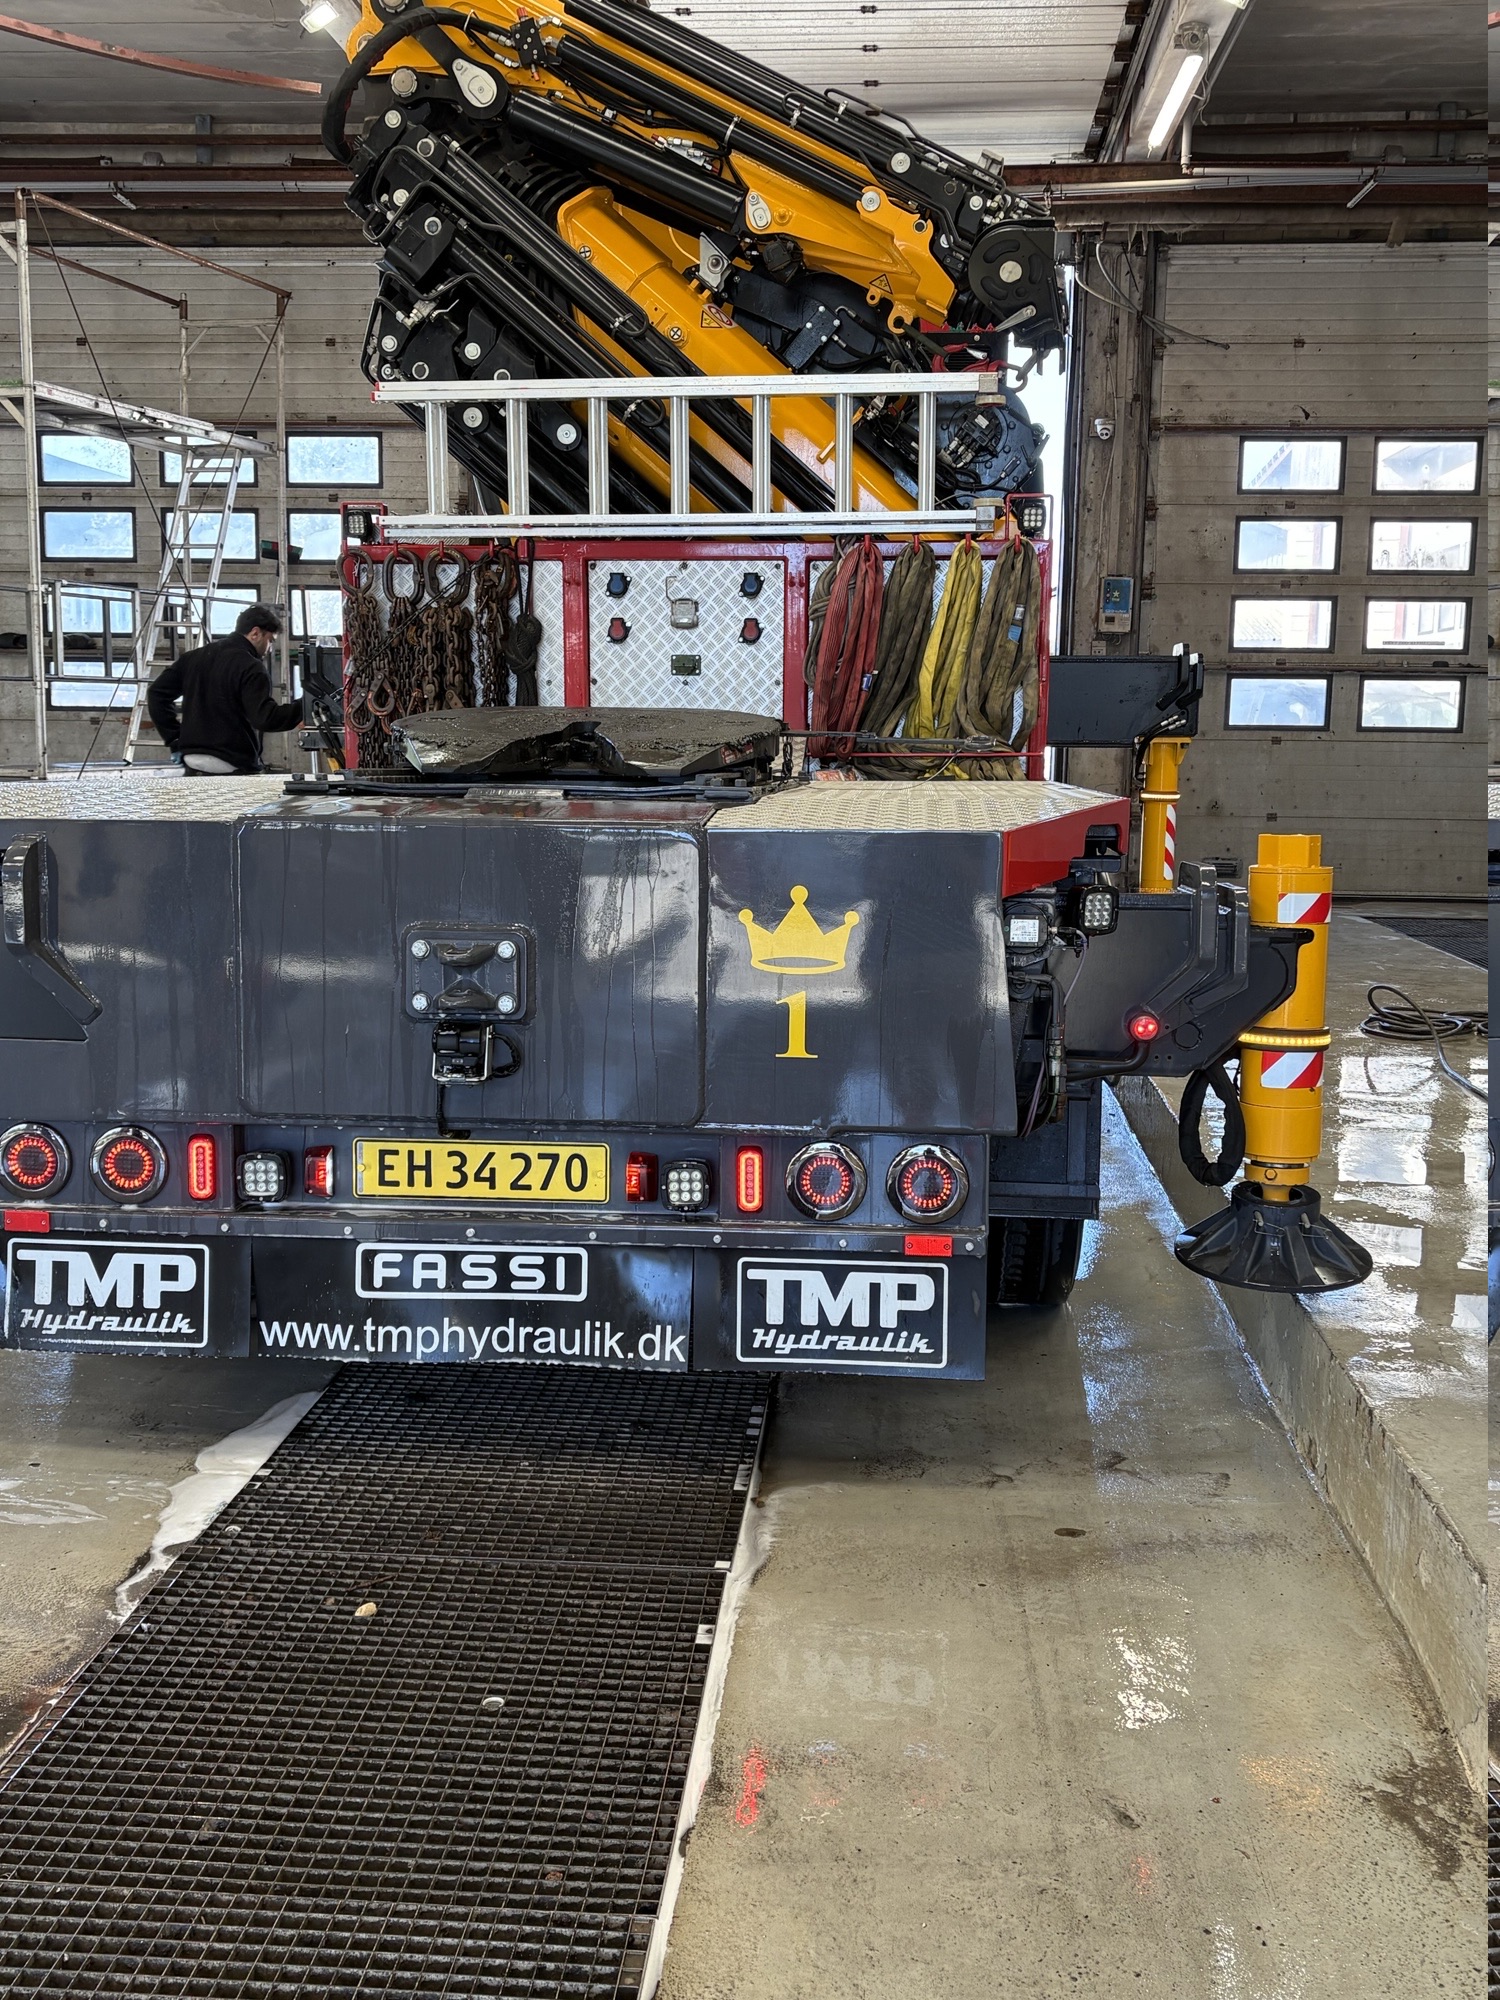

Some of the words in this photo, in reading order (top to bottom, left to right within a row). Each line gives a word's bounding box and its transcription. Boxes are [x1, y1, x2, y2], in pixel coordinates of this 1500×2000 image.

[776, 991, 818, 1058] 1
[378, 1149, 432, 1188] EH
[446, 1151, 496, 1190] 34
[510, 1153, 588, 1192] 270
[17, 1249, 197, 1309] TMP
[373, 1253, 566, 1291] FASSI
[747, 1268, 935, 1328] TMP
[20, 1309, 196, 1334] Hydraulik
[259, 1317, 686, 1362] www.tmphydraulik.dk
[752, 1329, 935, 1354] Hydraulik
